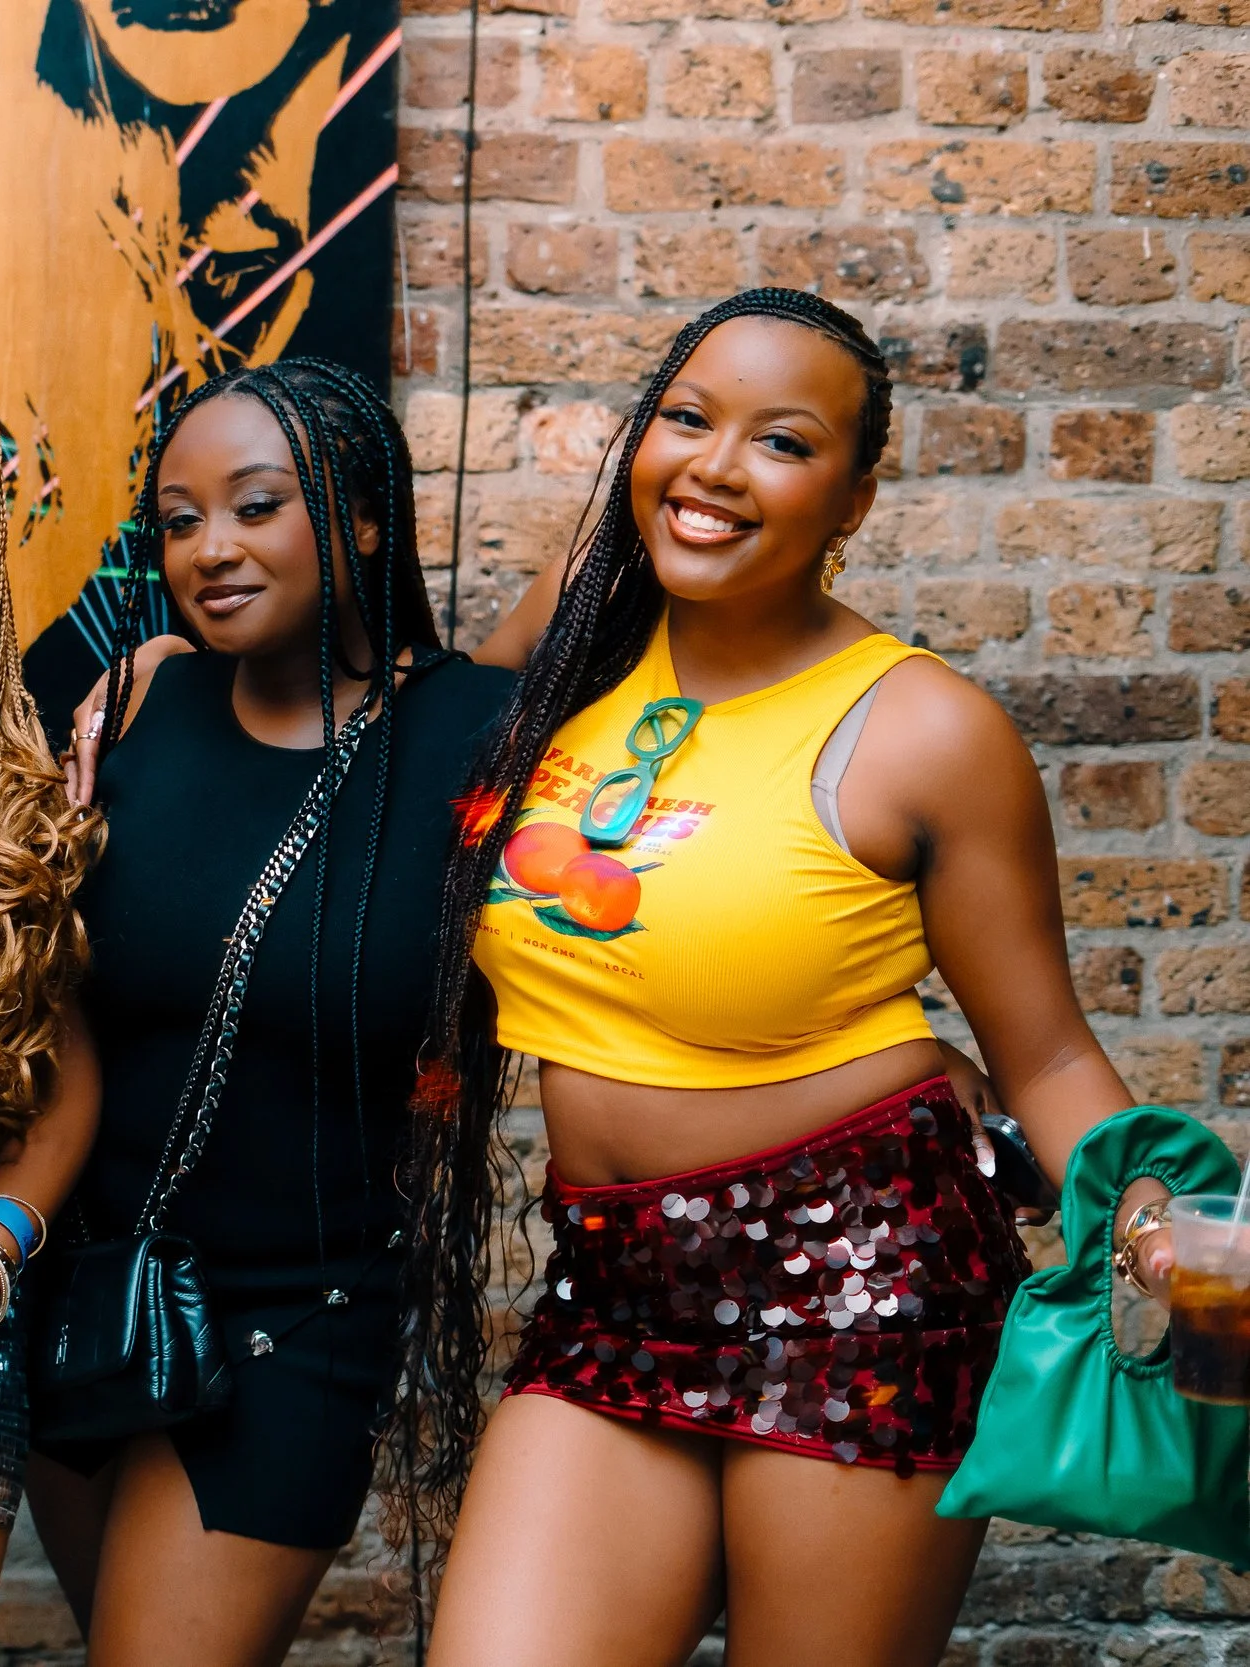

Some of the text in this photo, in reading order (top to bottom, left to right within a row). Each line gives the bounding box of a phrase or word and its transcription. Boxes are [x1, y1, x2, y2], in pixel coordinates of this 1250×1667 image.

[523, 937, 548, 950] NON
[552, 946, 576, 959] GMO
[605, 963, 645, 980] LOCAL
